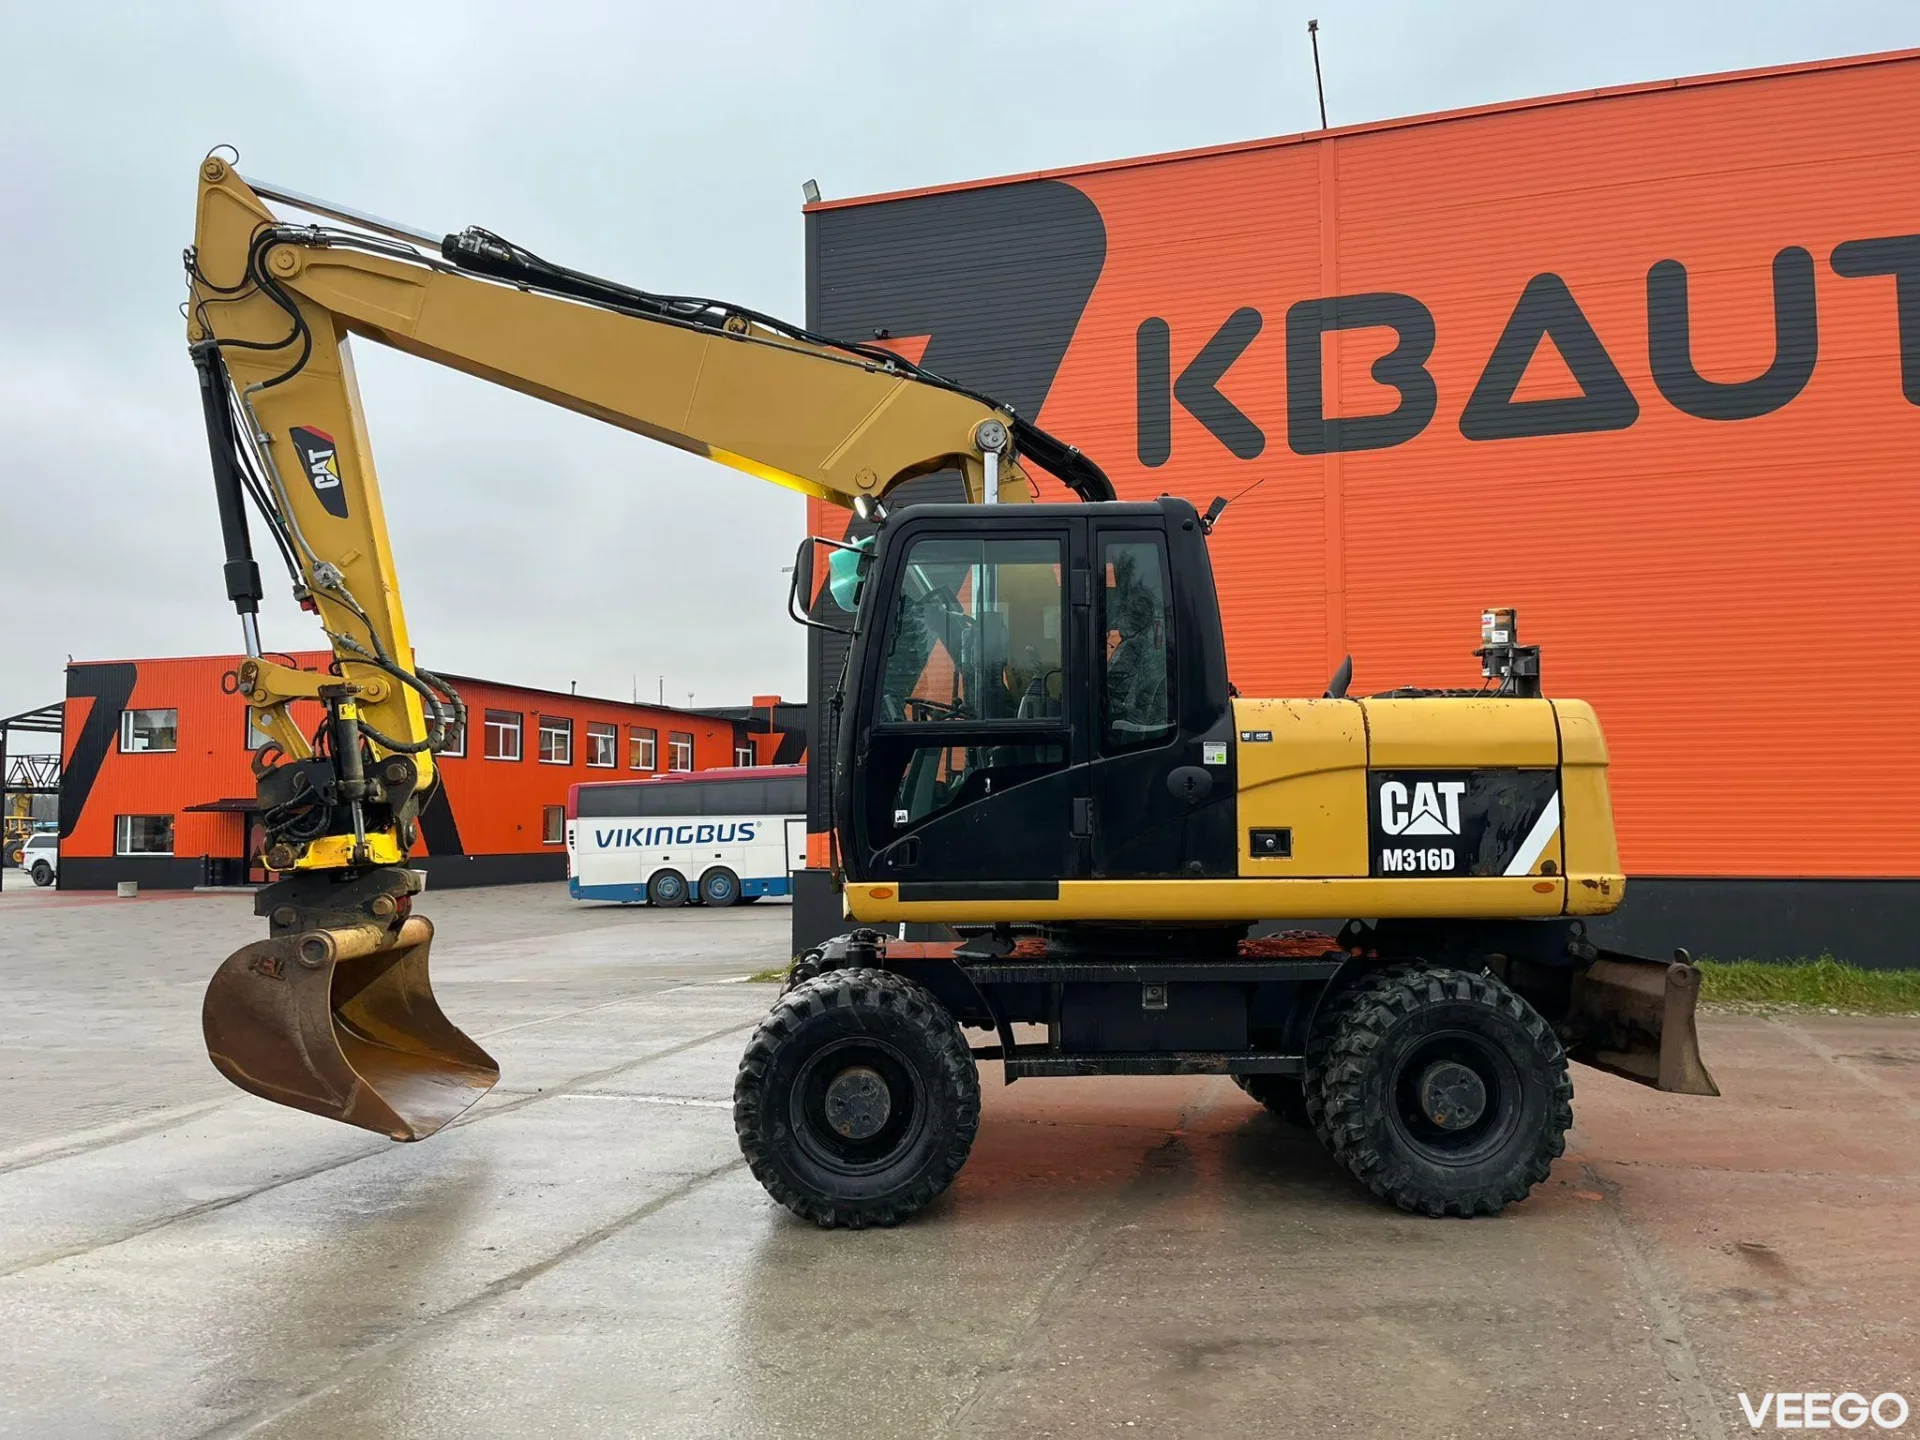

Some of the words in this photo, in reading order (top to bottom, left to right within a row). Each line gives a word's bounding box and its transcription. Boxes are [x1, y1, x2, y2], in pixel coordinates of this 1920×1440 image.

[308, 449, 340, 489] CAT
[1380, 781, 1465, 835] CAT
[595, 822, 756, 848] VIKINGBUS
[1382, 848, 1455, 871] M316D
